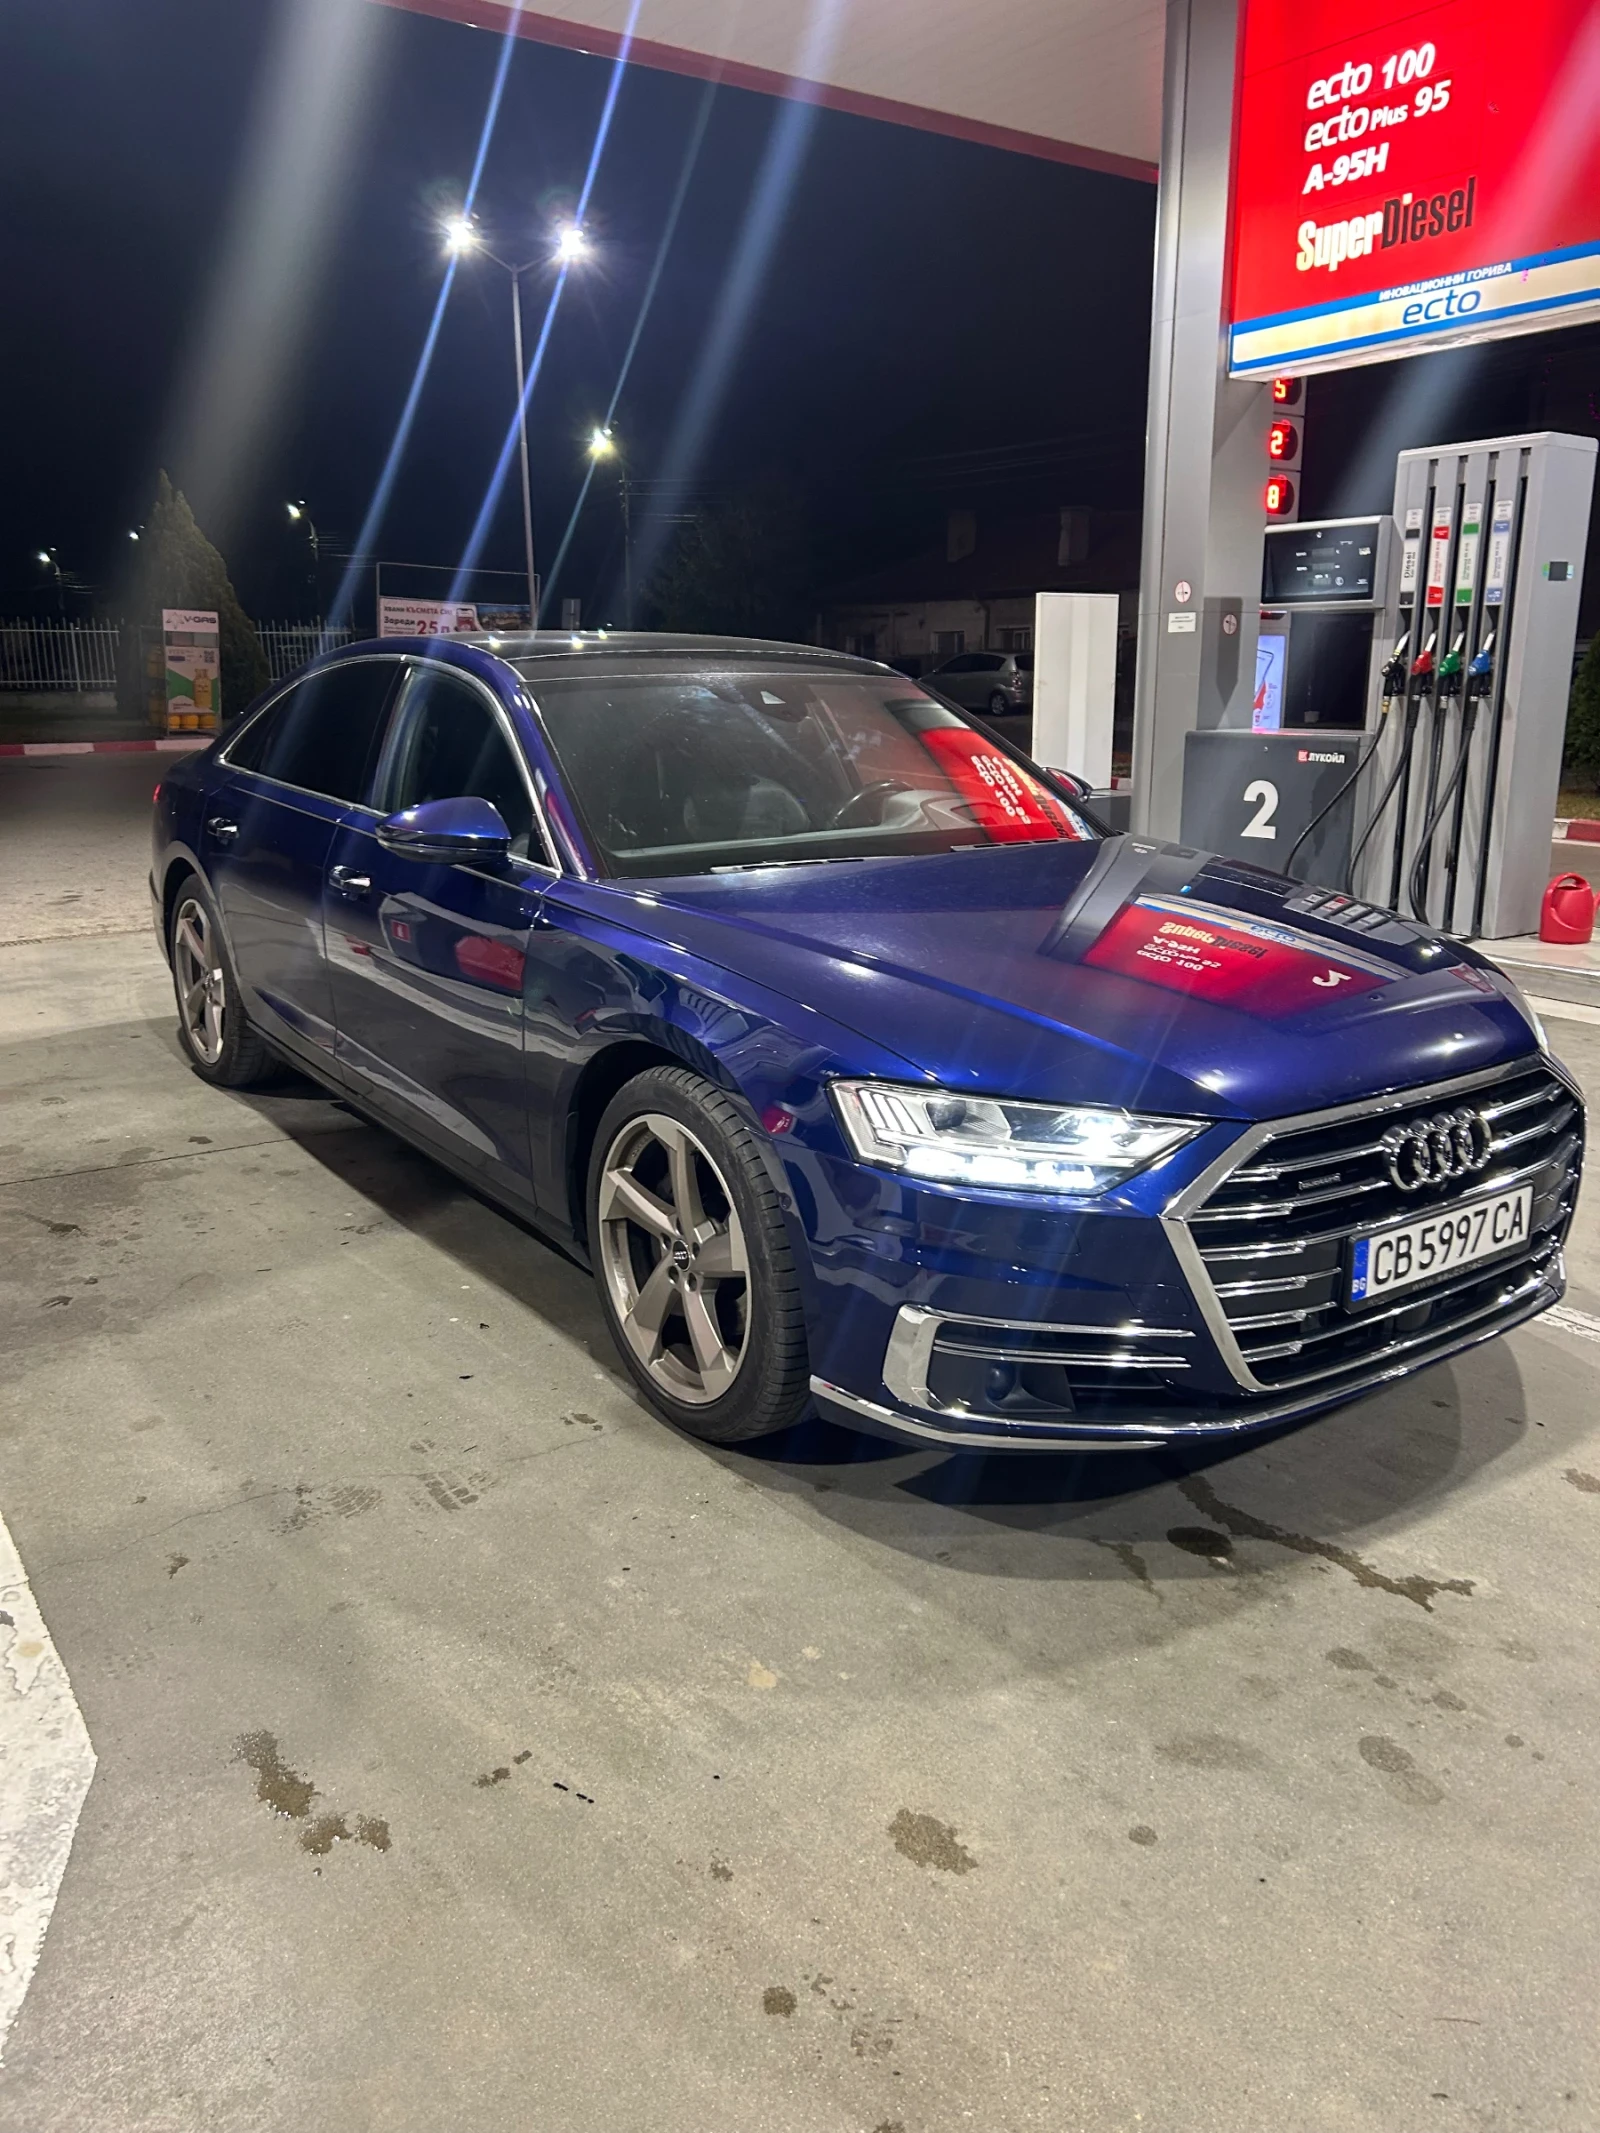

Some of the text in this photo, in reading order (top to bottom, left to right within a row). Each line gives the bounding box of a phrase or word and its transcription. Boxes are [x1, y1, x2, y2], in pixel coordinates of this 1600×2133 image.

[1306, 42, 1436, 110] ecto 100
[1413, 80, 1451, 118] 95
[1378, 262, 1512, 301] ИНОВАЦИОННИ ГОРИВА
[1402, 290, 1482, 325] ecto
[1270, 429, 1284, 456] 2
[1266, 484, 1280, 510] 8
[384, 616, 416, 626] Зареди
[416, 620, 438, 634] 25
[1308, 752, 1345, 763] ЛУКОЙЛ
[1240, 779, 1279, 840] 2
[1351, 1277, 1367, 1295] BG
